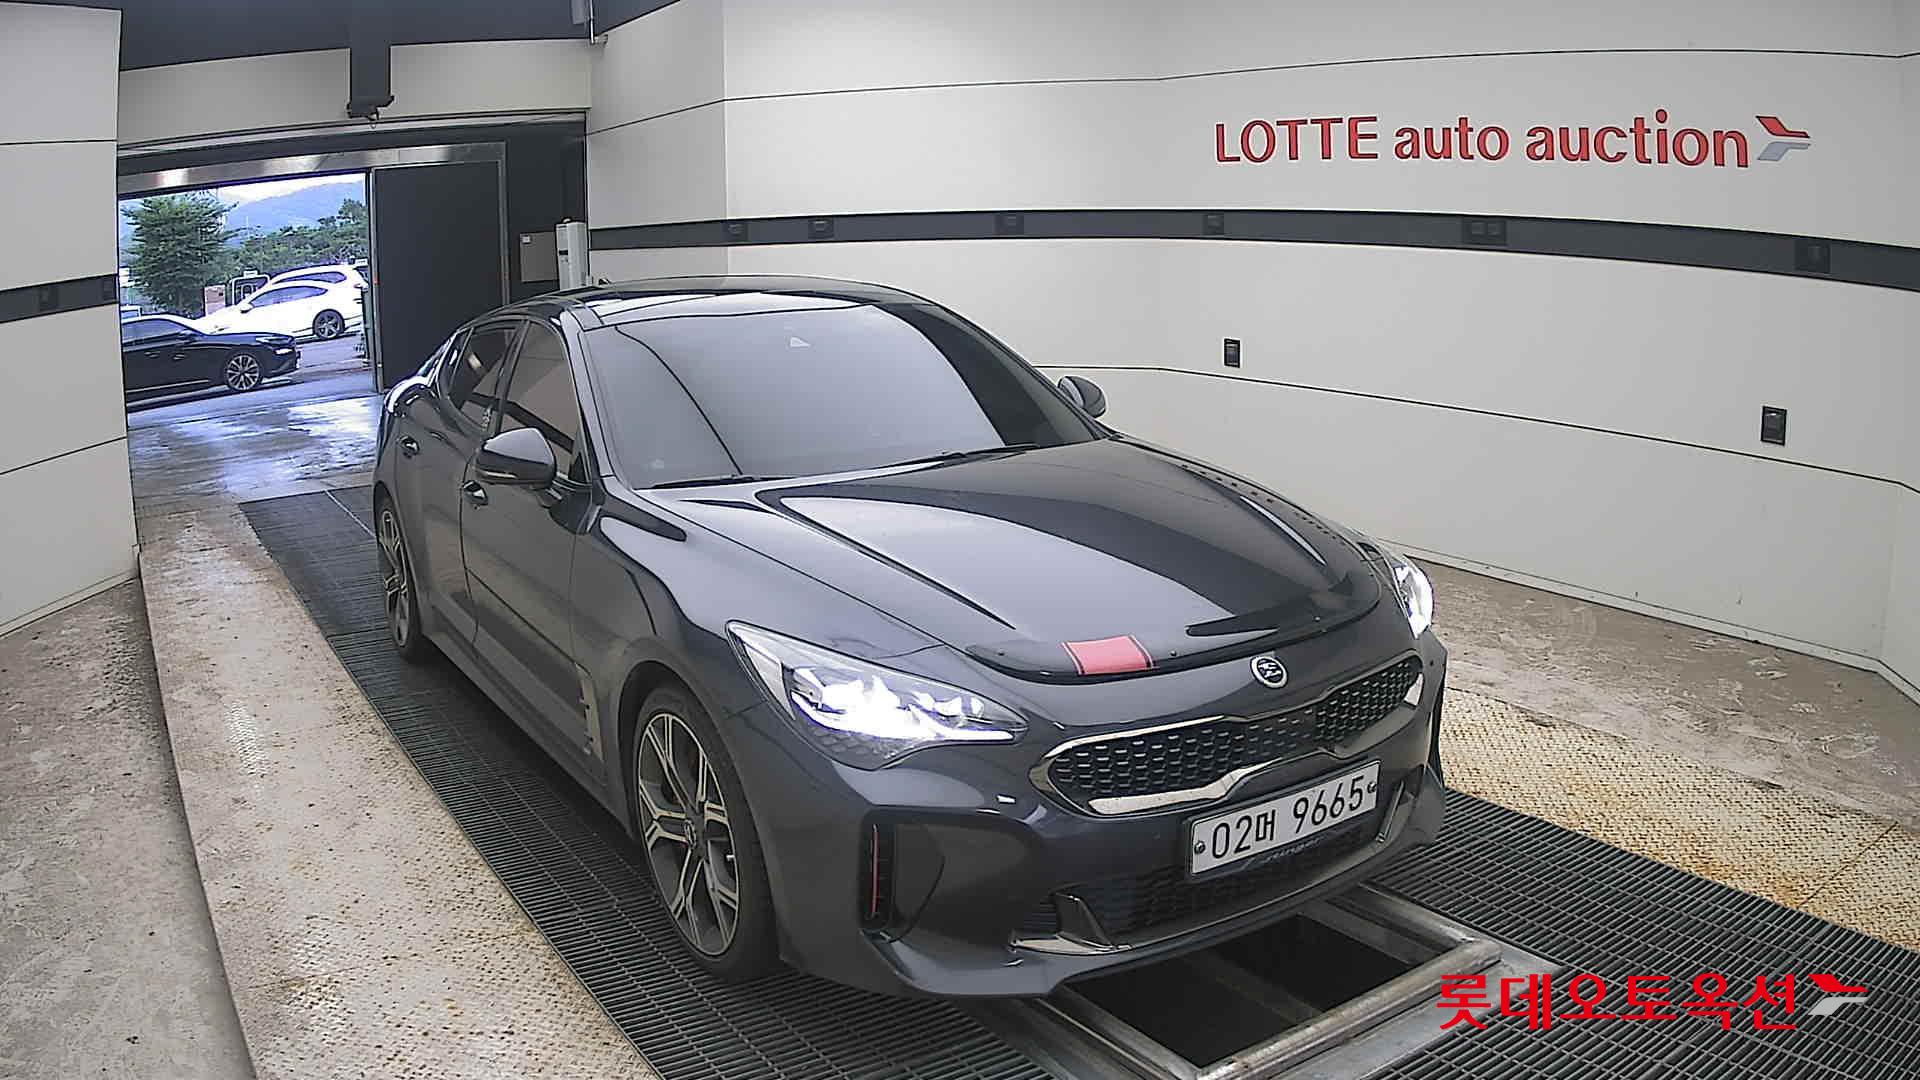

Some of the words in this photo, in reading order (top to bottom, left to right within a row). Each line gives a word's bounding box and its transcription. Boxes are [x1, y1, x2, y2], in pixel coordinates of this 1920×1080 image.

[1215, 116, 1378, 163] LOTTE
[1394, 116, 1510, 161] auto
[1526, 109, 1749, 168] auction
[1211, 809, 1276, 859] 02머
[1293, 775, 1365, 834] 9665
